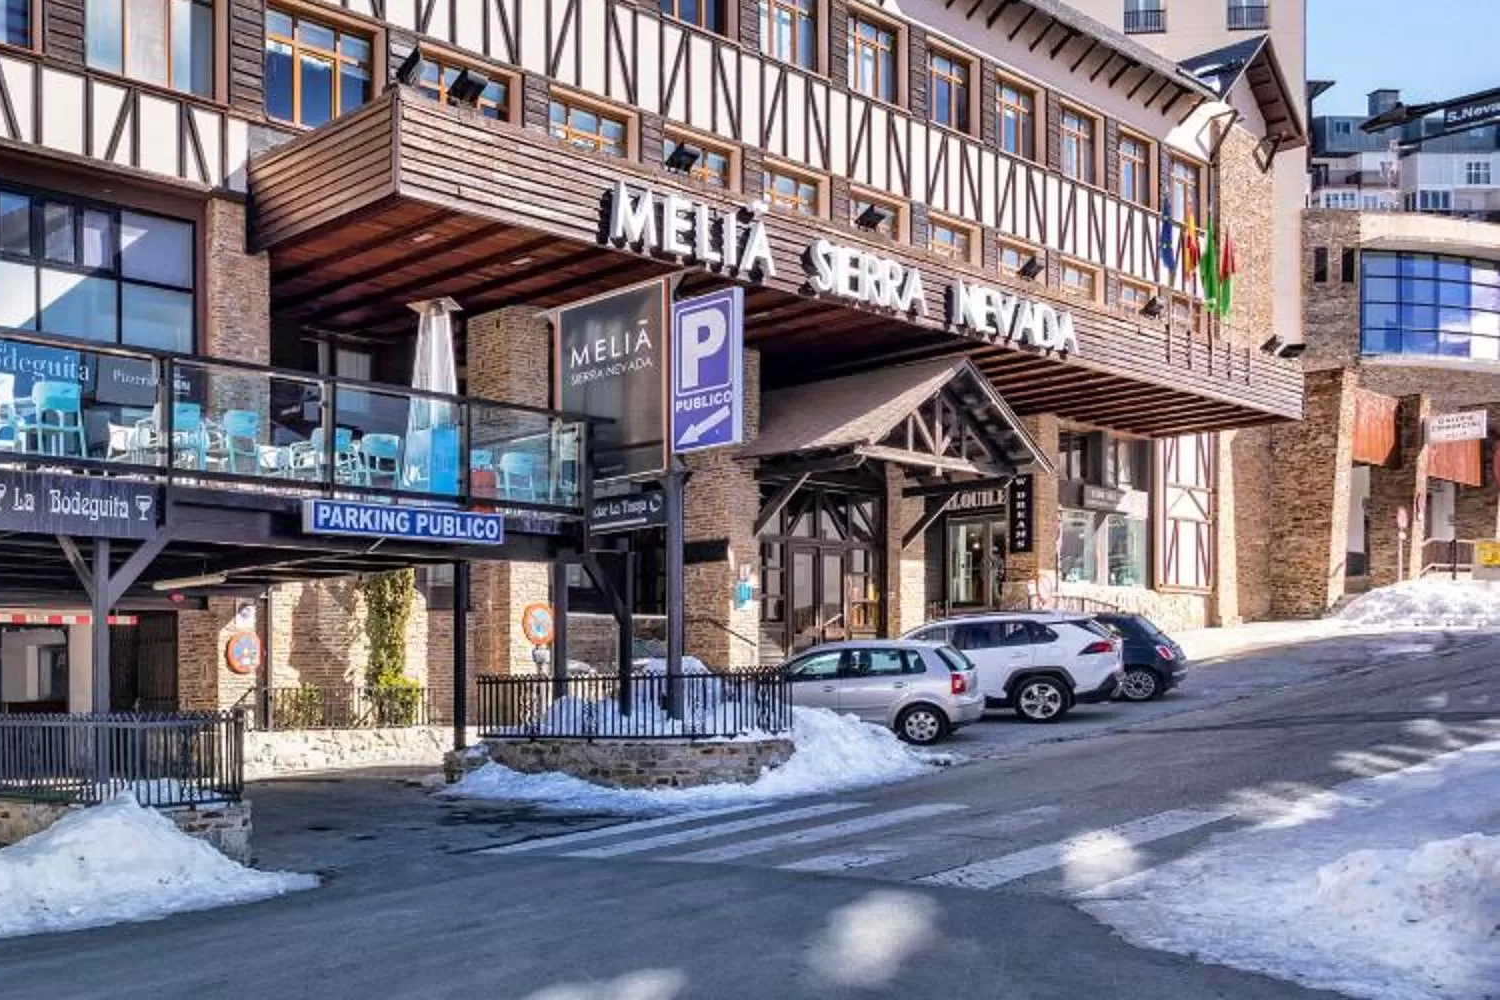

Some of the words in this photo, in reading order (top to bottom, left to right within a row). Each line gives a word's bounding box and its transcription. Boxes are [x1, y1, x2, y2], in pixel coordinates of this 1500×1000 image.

[808, 238, 928, 318] SIERRA
[952, 277, 1080, 358] NEVADA
[681, 307, 727, 389] P
[605, 356, 653, 378] NEVADA
[675, 390, 733, 413] PUBLICO
[11, 487, 35, 512] La
[49, 489, 130, 521] Bodeguita
[317, 504, 411, 533] PARKING
[415, 512, 500, 539] PUBLICO
